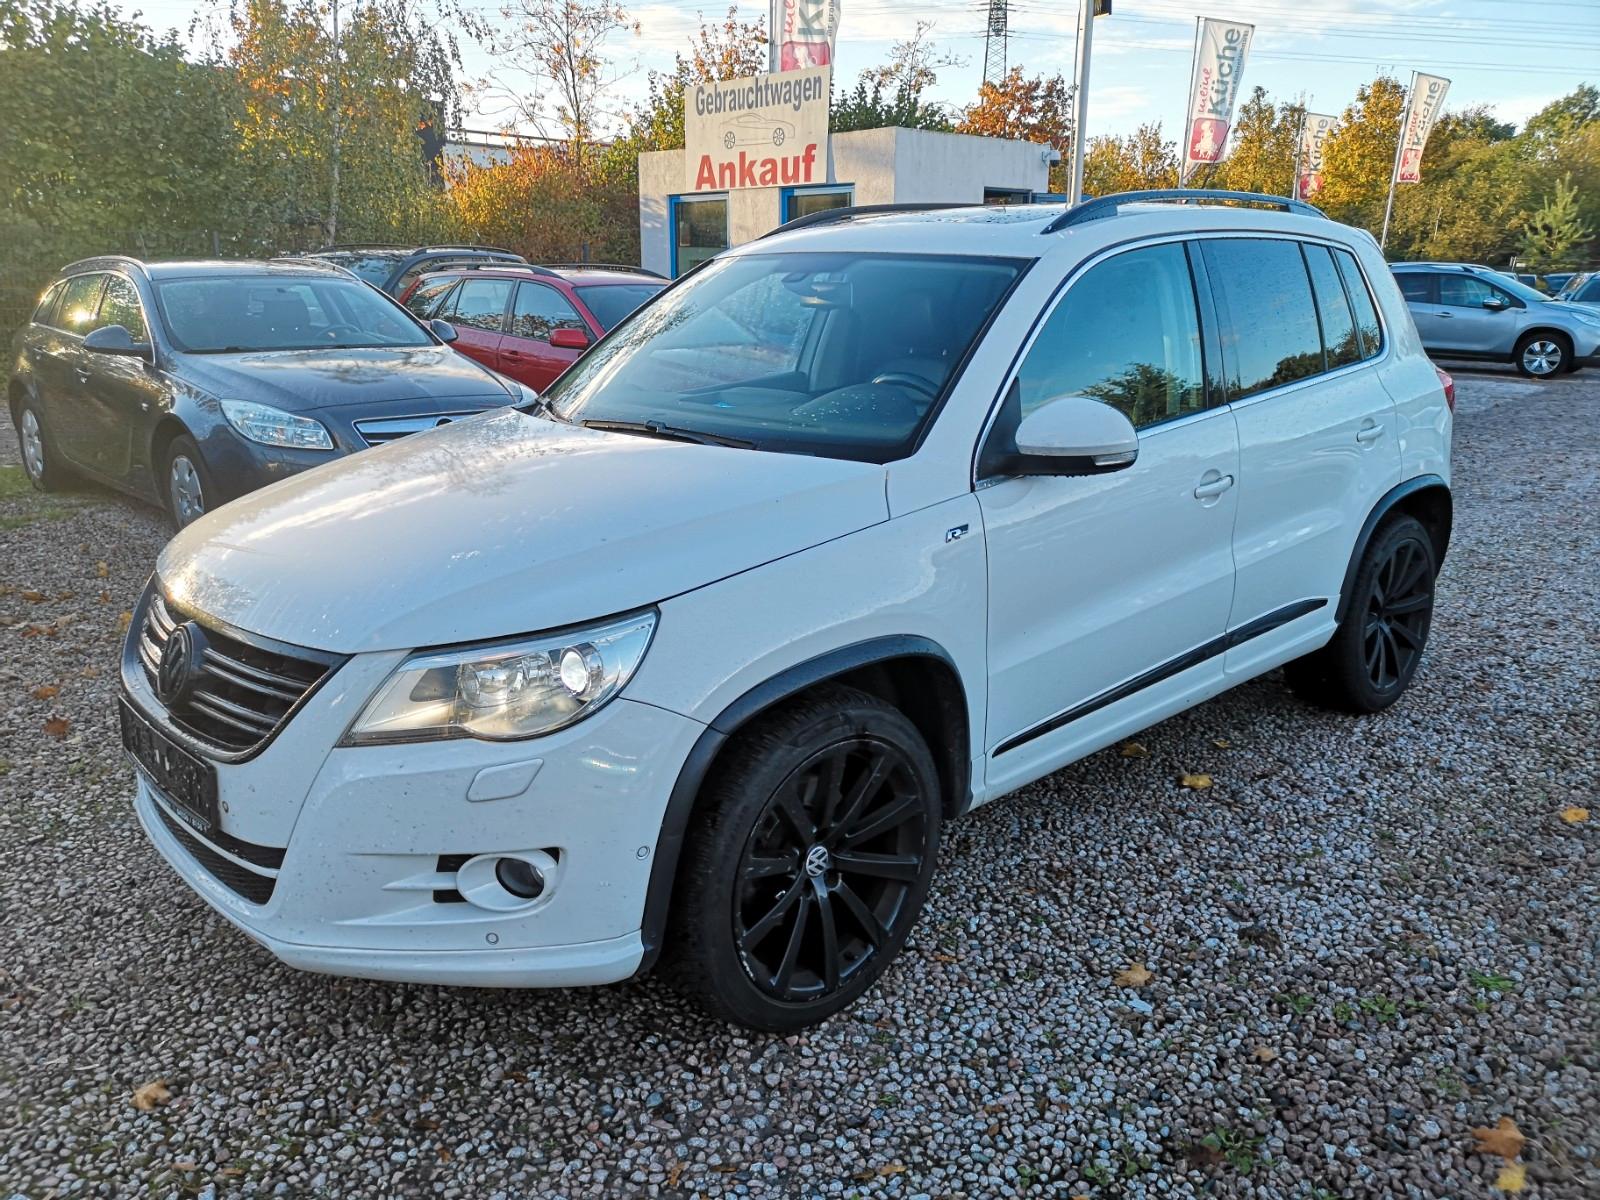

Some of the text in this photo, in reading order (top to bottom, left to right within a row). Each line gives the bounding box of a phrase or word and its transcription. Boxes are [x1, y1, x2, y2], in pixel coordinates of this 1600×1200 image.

[797, 0, 825, 35] K
[1207, 28, 1241, 116] Küche
[696, 75, 822, 116] Gebrauchtwagen
[695, 143, 818, 190] Ankauf
